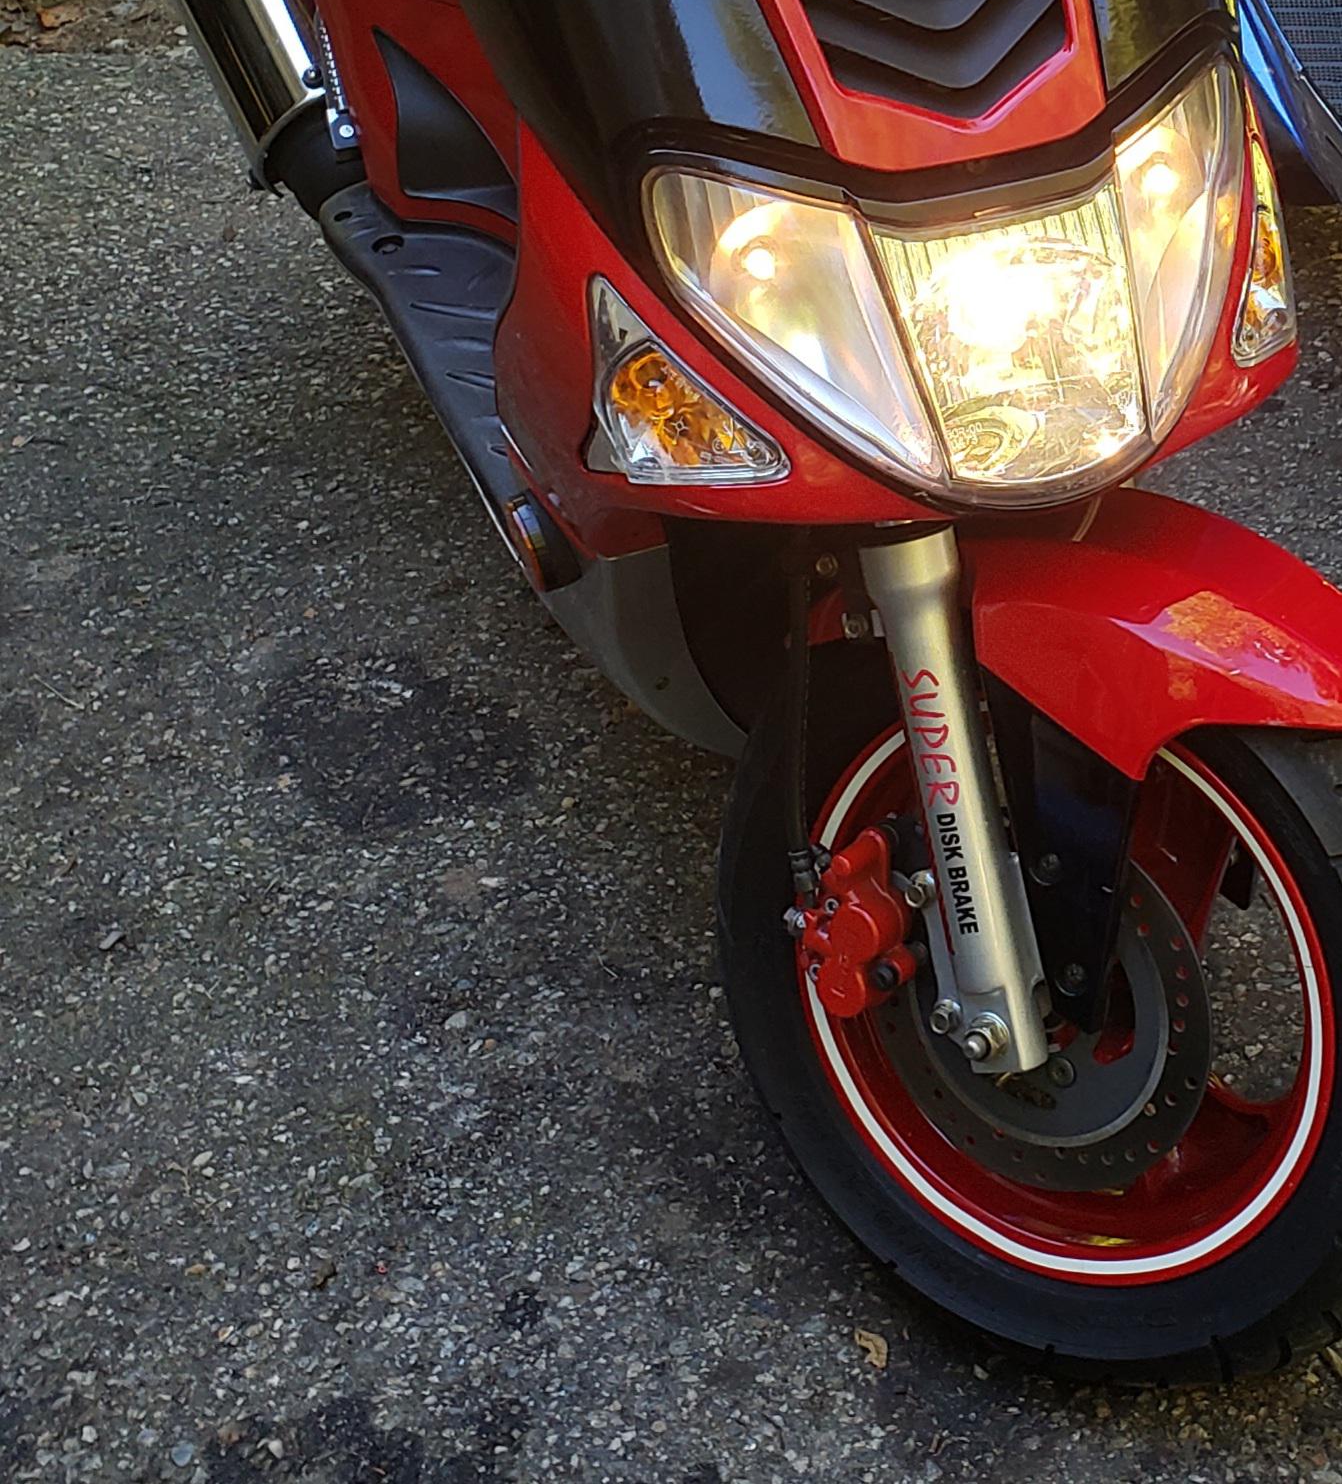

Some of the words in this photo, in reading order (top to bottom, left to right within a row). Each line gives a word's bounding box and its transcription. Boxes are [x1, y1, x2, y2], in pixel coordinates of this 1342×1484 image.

[901, 669, 960, 808] SUPER
[937, 813, 964, 861] DISK
[947, 866, 979, 935] BRAKE
